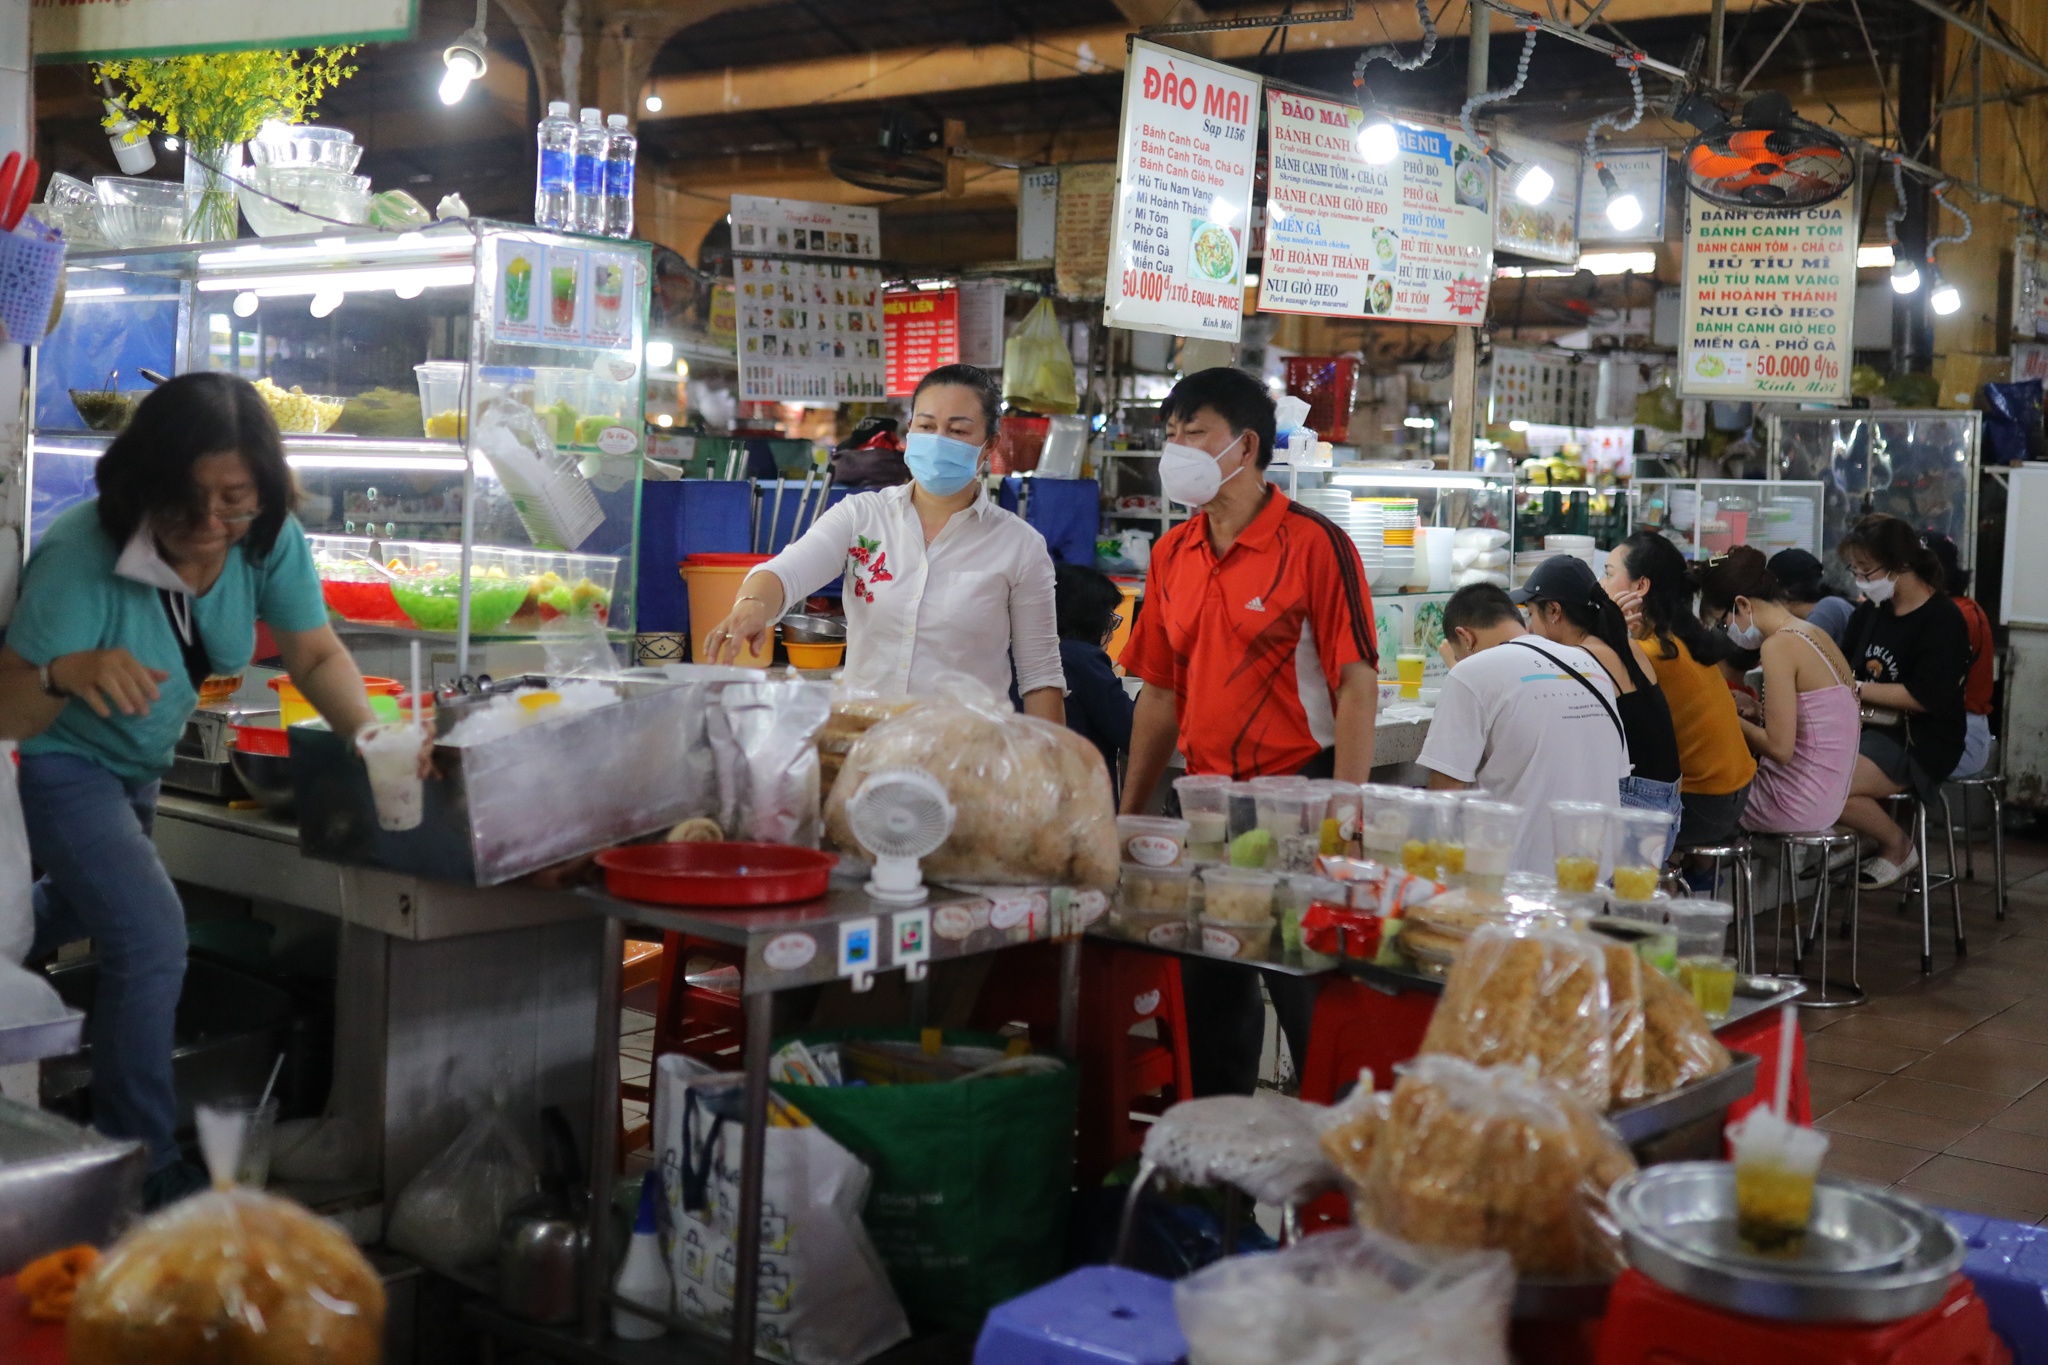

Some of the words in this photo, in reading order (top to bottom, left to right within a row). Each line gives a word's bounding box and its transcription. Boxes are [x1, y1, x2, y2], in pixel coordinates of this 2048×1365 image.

[1144, 60, 1196, 110] ĐÀO
[1203, 84, 1248, 125] MAI
[1282, 100, 1314, 121] ĐÀO
[1319, 109, 1350, 128] MAI
[1143, 124, 1166, 140] Bánh
[1169, 132, 1190, 146] Canh
[1194, 138, 1210, 152] Cua
[1203, 119, 1222, 138] Sạp
[1225, 126, 1245, 141] 1156
[1275, 125, 1311, 145] BÁNH
[1316, 135, 1350, 152] CANH
[1141, 141, 1164, 156] Bánh
[1168, 148, 1189, 162] Canh
[1193, 154, 1212, 169] Tôm,
[1216, 160, 1231, 173] Chả
[1234, 165, 1244, 176] Cá
[1280, 143, 1295, 153] Crab
[1296, 147, 1330, 158] vietnamese
[1331, 153, 1346, 161] udon
[1140, 157, 1163, 172] Bánh
[1166, 164, 1188, 178] Canh
[1191, 170, 1205, 182] Giò
[1208, 174, 1224, 186] Heo
[1275, 154, 1300, 172] BÁNH
[1303, 160, 1327, 177] CANH
[1330, 163, 1348, 180] TÔM
[1358, 168, 1374, 183] CHẢ
[1377, 171, 1388, 186] CÁ
[1404, 159, 1423, 173] PHỞ
[1426, 163, 1439, 177] BÒ
[1029, 175, 1058, 187] 1132
[1138, 175, 1151, 187] Hủ
[1171, 182, 1189, 195] Nam
[1192, 187, 1213, 203] Vang
[1280, 172, 1300, 184] Shrimp
[1302, 178, 1333, 188] vietnamese
[1335, 182, 1348, 190] udon
[1275, 185, 1306, 204] BÁNH
[1310, 193, 1340, 209] CANH
[1344, 196, 1363, 211] GIÒ
[1367, 201, 1388, 215] HEO
[1404, 185, 1423, 200] PHỞ
[1426, 189, 1438, 203] GÀ
[1137, 192, 1147, 204] Mì
[1150, 196, 1179, 210] Hoành
[1182, 202, 1208, 216] Thánh
[1135, 208, 1146, 219] Mì
[1150, 211, 1168, 224] Tôm
[1294, 207, 1316, 216] sausage
[1330, 211, 1360, 220] vietnamese
[1403, 211, 1422, 226] PHỞ
[1425, 215, 1445, 229] TÔM
[1753, 210, 1800, 220] CANH
[1807, 209, 1842, 220] CUA
[1134, 223, 1152, 235] Phở
[1156, 226, 1168, 239] Gà
[1273, 214, 1303, 232] MIẾN
[1306, 220, 1321, 236] GÀ
[1700, 224, 1746, 237] BÁNH
[1752, 226, 1799, 236] CANH
[1806, 224, 1843, 236] TÔM
[1132, 240, 1154, 254] Miến
[1158, 244, 1169, 256] Gà
[1291, 237, 1313, 245] noodles
[1401, 236, 1414, 251] HỦ
[1436, 244, 1455, 256] NAM
[1698, 240, 1727, 253] BÁNH
[1731, 243, 1761, 253] CANH
[1765, 240, 1788, 253] TÔM
[1802, 238, 1825, 252] CHẢ
[1828, 239, 1844, 252] CÁ
[1131, 256, 1153, 269] Miến
[1156, 260, 1173, 273] Cua
[1270, 245, 1284, 262] MÌ
[1288, 248, 1328, 266] HOÀNH
[1332, 254, 1369, 271] THÁNH
[1709, 255, 1743, 269] HỦ
[1802, 256, 1831, 269] MÌ
[1274, 264, 1284, 273] Egg
[1399, 262, 1412, 277] HỦ
[1433, 267, 1451, 281] XÀO
[1698, 270, 1719, 285] HỦ
[1755, 275, 1789, 284] NAM
[1795, 275, 1839, 285] VANG
[1266, 279, 1287, 292] NUI
[1291, 279, 1311, 294] GIÒ
[1315, 283, 1338, 297] HEO
[1396, 289, 1407, 303] MÌ
[1411, 291, 1430, 304] TÔM
[1722, 287, 1776, 301] HOÀNH
[1782, 287, 1837, 301] THÁNH
[1700, 307, 1738, 316] NUI
[1745, 305, 1784, 316] GIÒ
[1790, 307, 1834, 318] HEO
[1202, 317, 1218, 328] Kính
[1220, 319, 1233, 329] Mời
[1696, 320, 1732, 332] BÁNH
[1737, 323, 1774, 333] CANH
[1780, 320, 1803, 333] GIÒ
[1808, 324, 1836, 334] HEO
[1694, 334, 1733, 348] MIẾN
[1739, 337, 1760, 349] GÀ
[1775, 336, 1808, 350] PHỞ
[1814, 338, 1836, 351] GÀ
[1754, 379, 1795, 392] Kính
